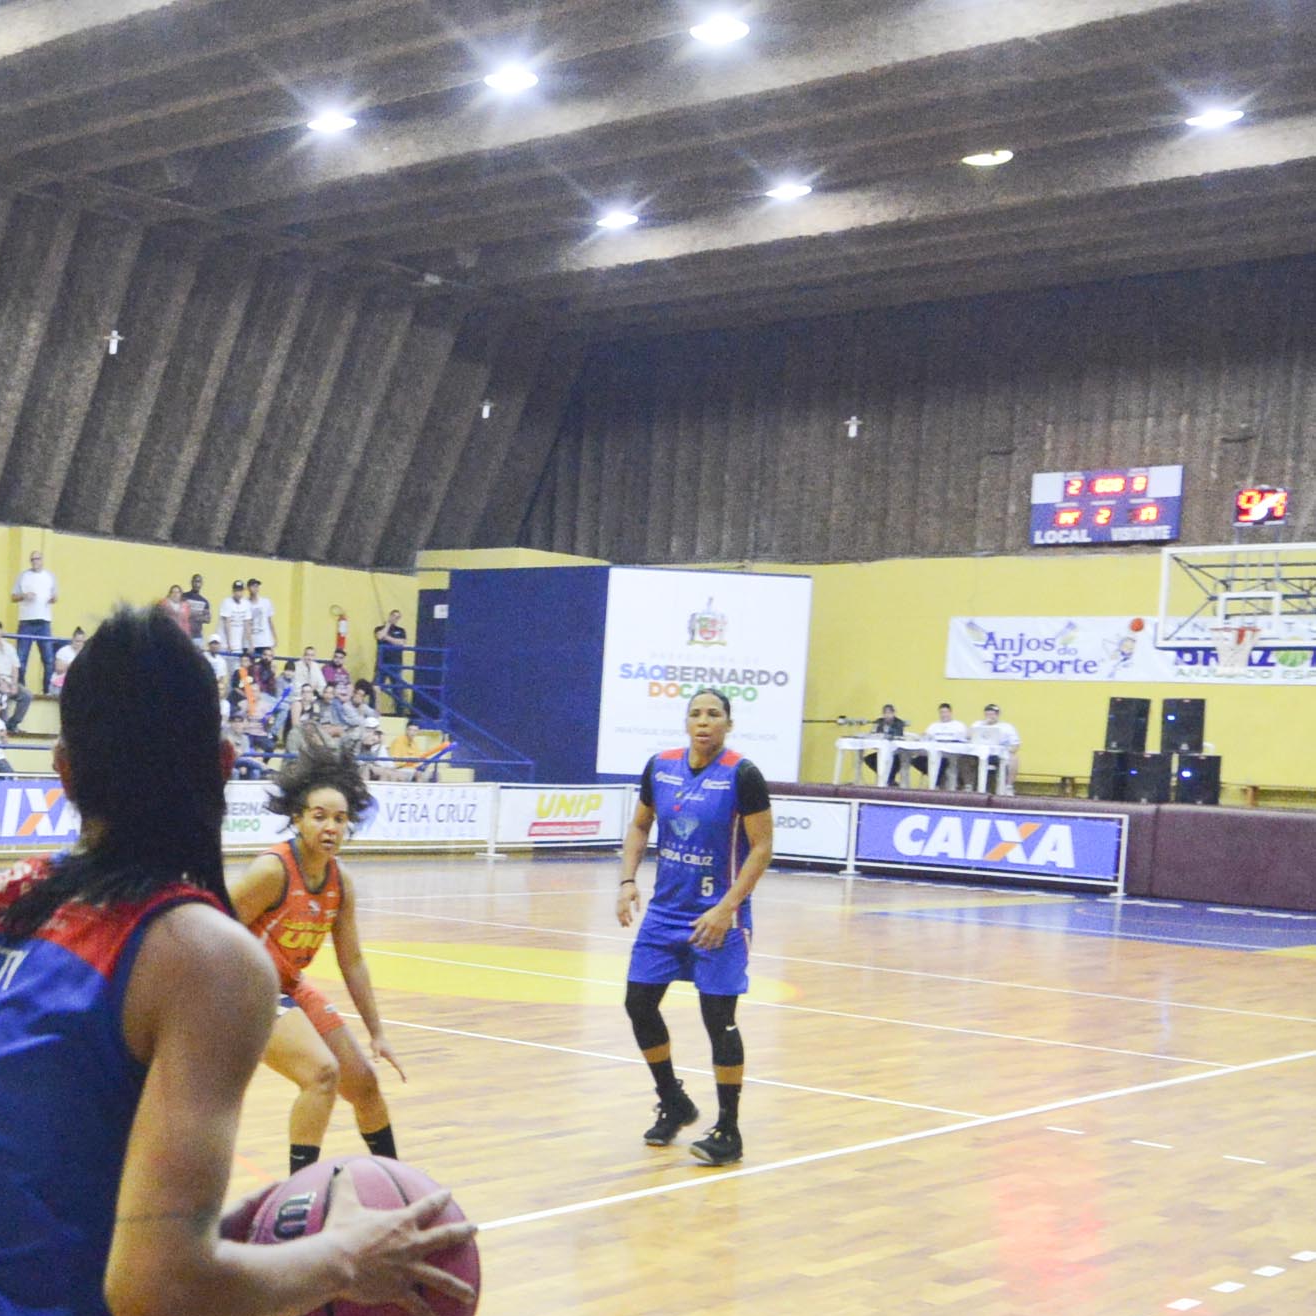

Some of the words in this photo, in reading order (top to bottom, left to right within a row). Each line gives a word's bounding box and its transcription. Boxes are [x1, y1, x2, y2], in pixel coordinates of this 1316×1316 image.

[1033, 528, 1092, 545] LOCAL
[975, 632, 1056, 656] Anjos
[984, 653, 1098, 678] Esporte
[648, 681, 759, 702] DOCPO
[386, 802, 430, 823] VERA
[435, 803, 478, 823] CRUZ
[535, 792, 604, 819] UNIP
[892, 814, 1076, 869] CAIXA
[701, 876, 715, 897] 5
